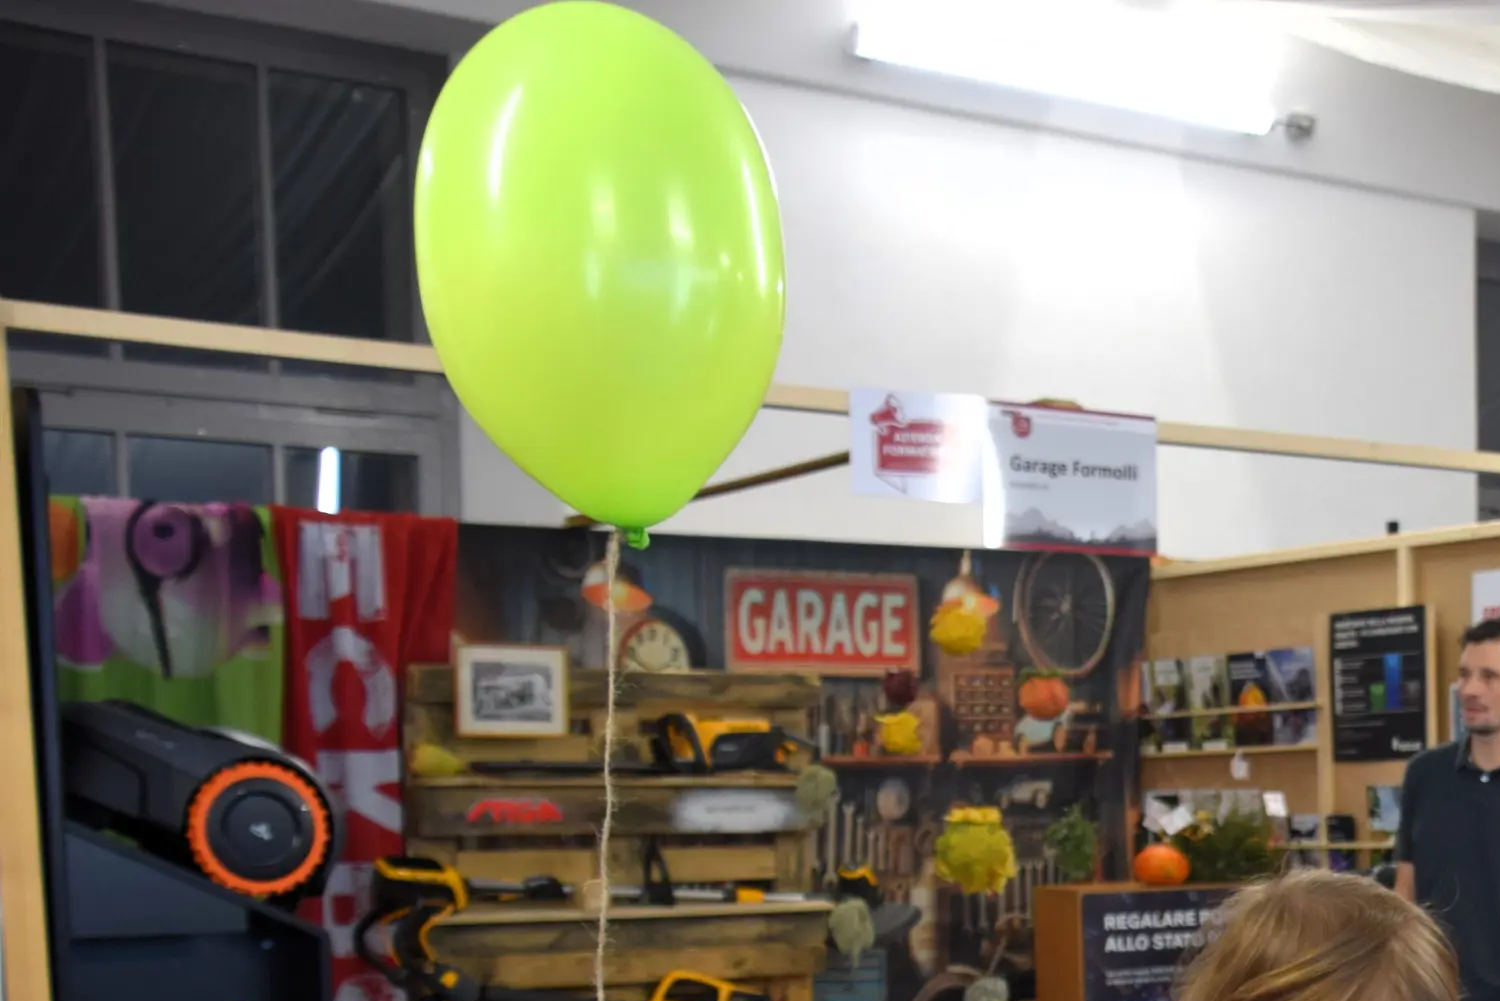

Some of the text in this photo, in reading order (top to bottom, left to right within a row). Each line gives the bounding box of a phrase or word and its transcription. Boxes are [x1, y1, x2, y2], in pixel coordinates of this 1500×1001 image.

[1009, 453, 1067, 479] Garage
[738, 588, 906, 658] GARAGE
[1103, 908, 1198, 931] REGALARE
[1104, 933, 1150, 953] ALLO
